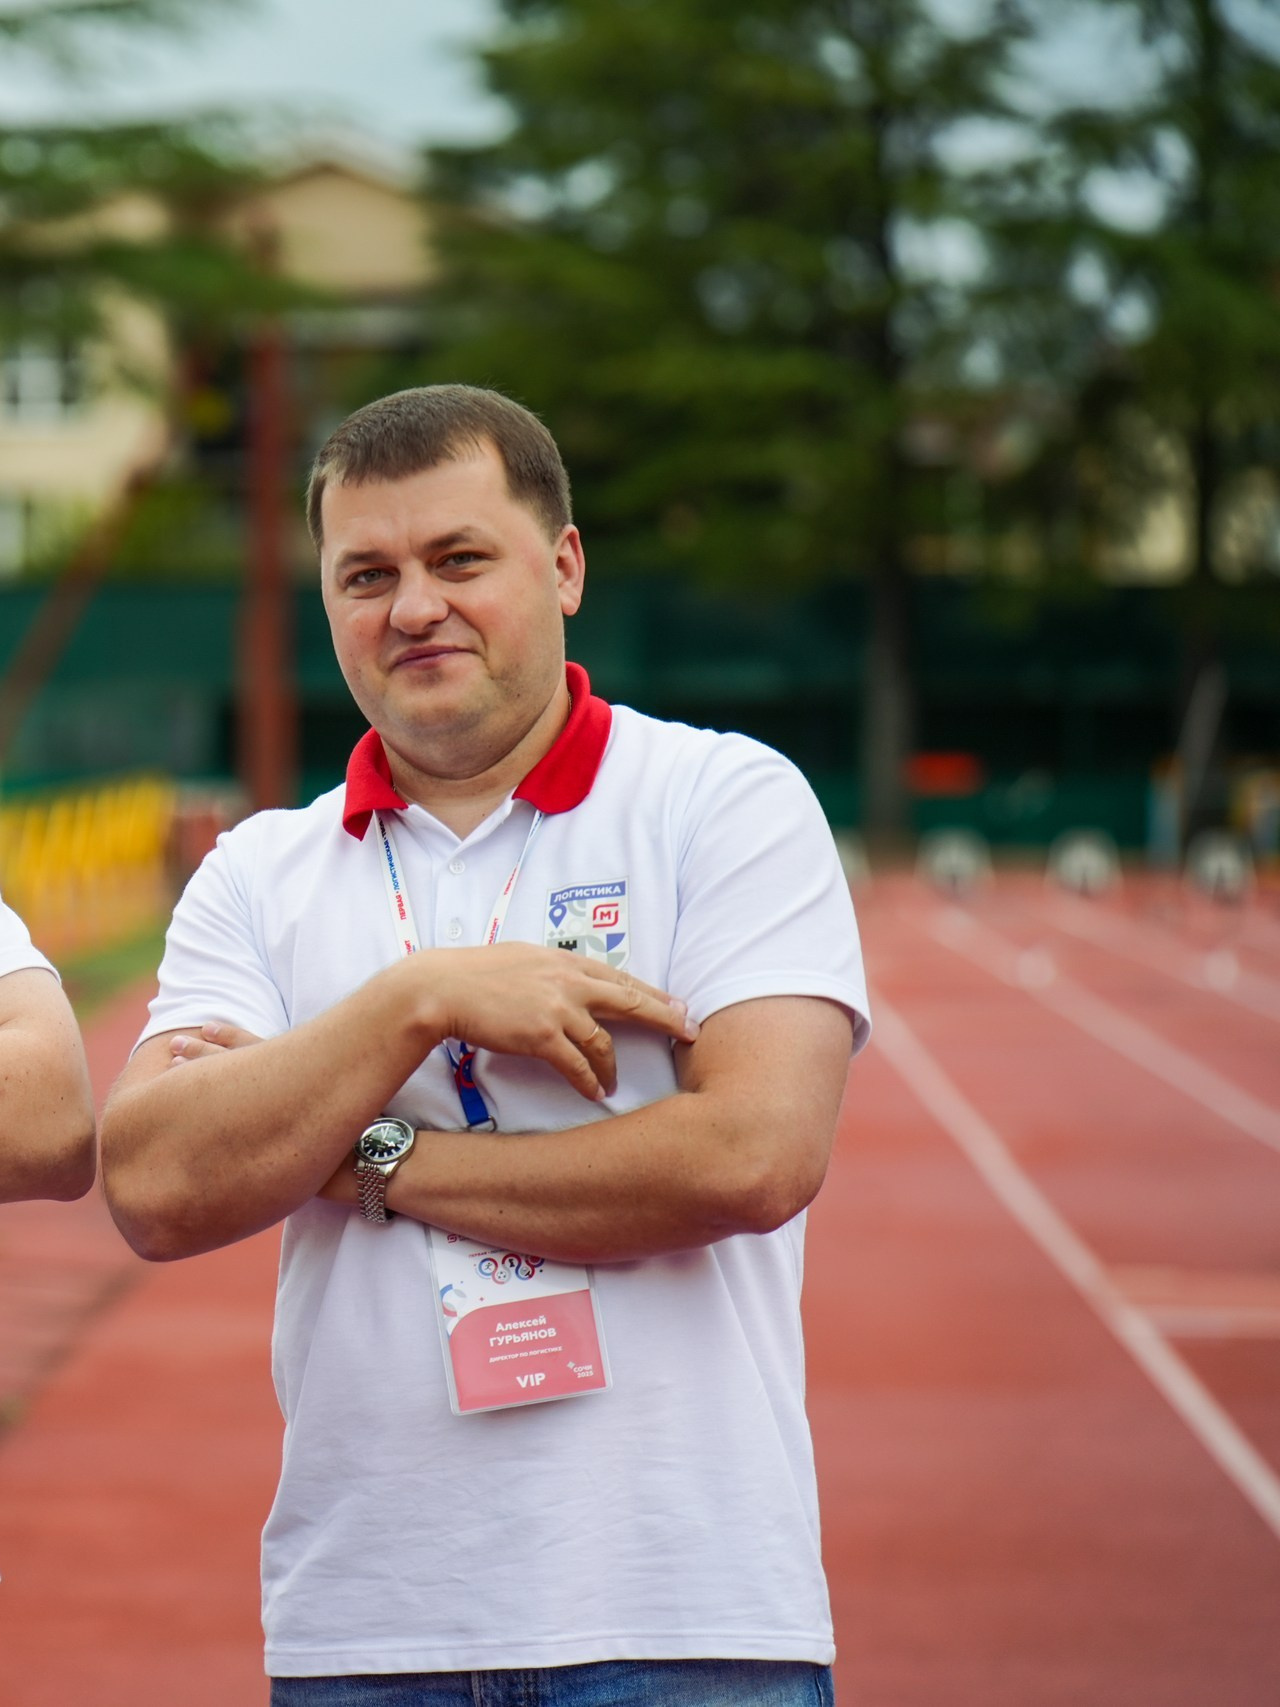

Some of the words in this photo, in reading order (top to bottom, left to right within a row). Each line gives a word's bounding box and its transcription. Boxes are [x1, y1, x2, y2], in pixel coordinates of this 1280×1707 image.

[384, 839, 400, 890] ЛОГИСТИЧЕСКАЯ
[553, 885, 622, 903] ЛОГИСТИКА
[396, 894, 407, 920] ПЕРВАЯ
[495, 1315, 547, 1332] Алексей
[489, 1327, 557, 1347] ГУРЬЯНОВ
[516, 1372, 546, 1388] VIP
